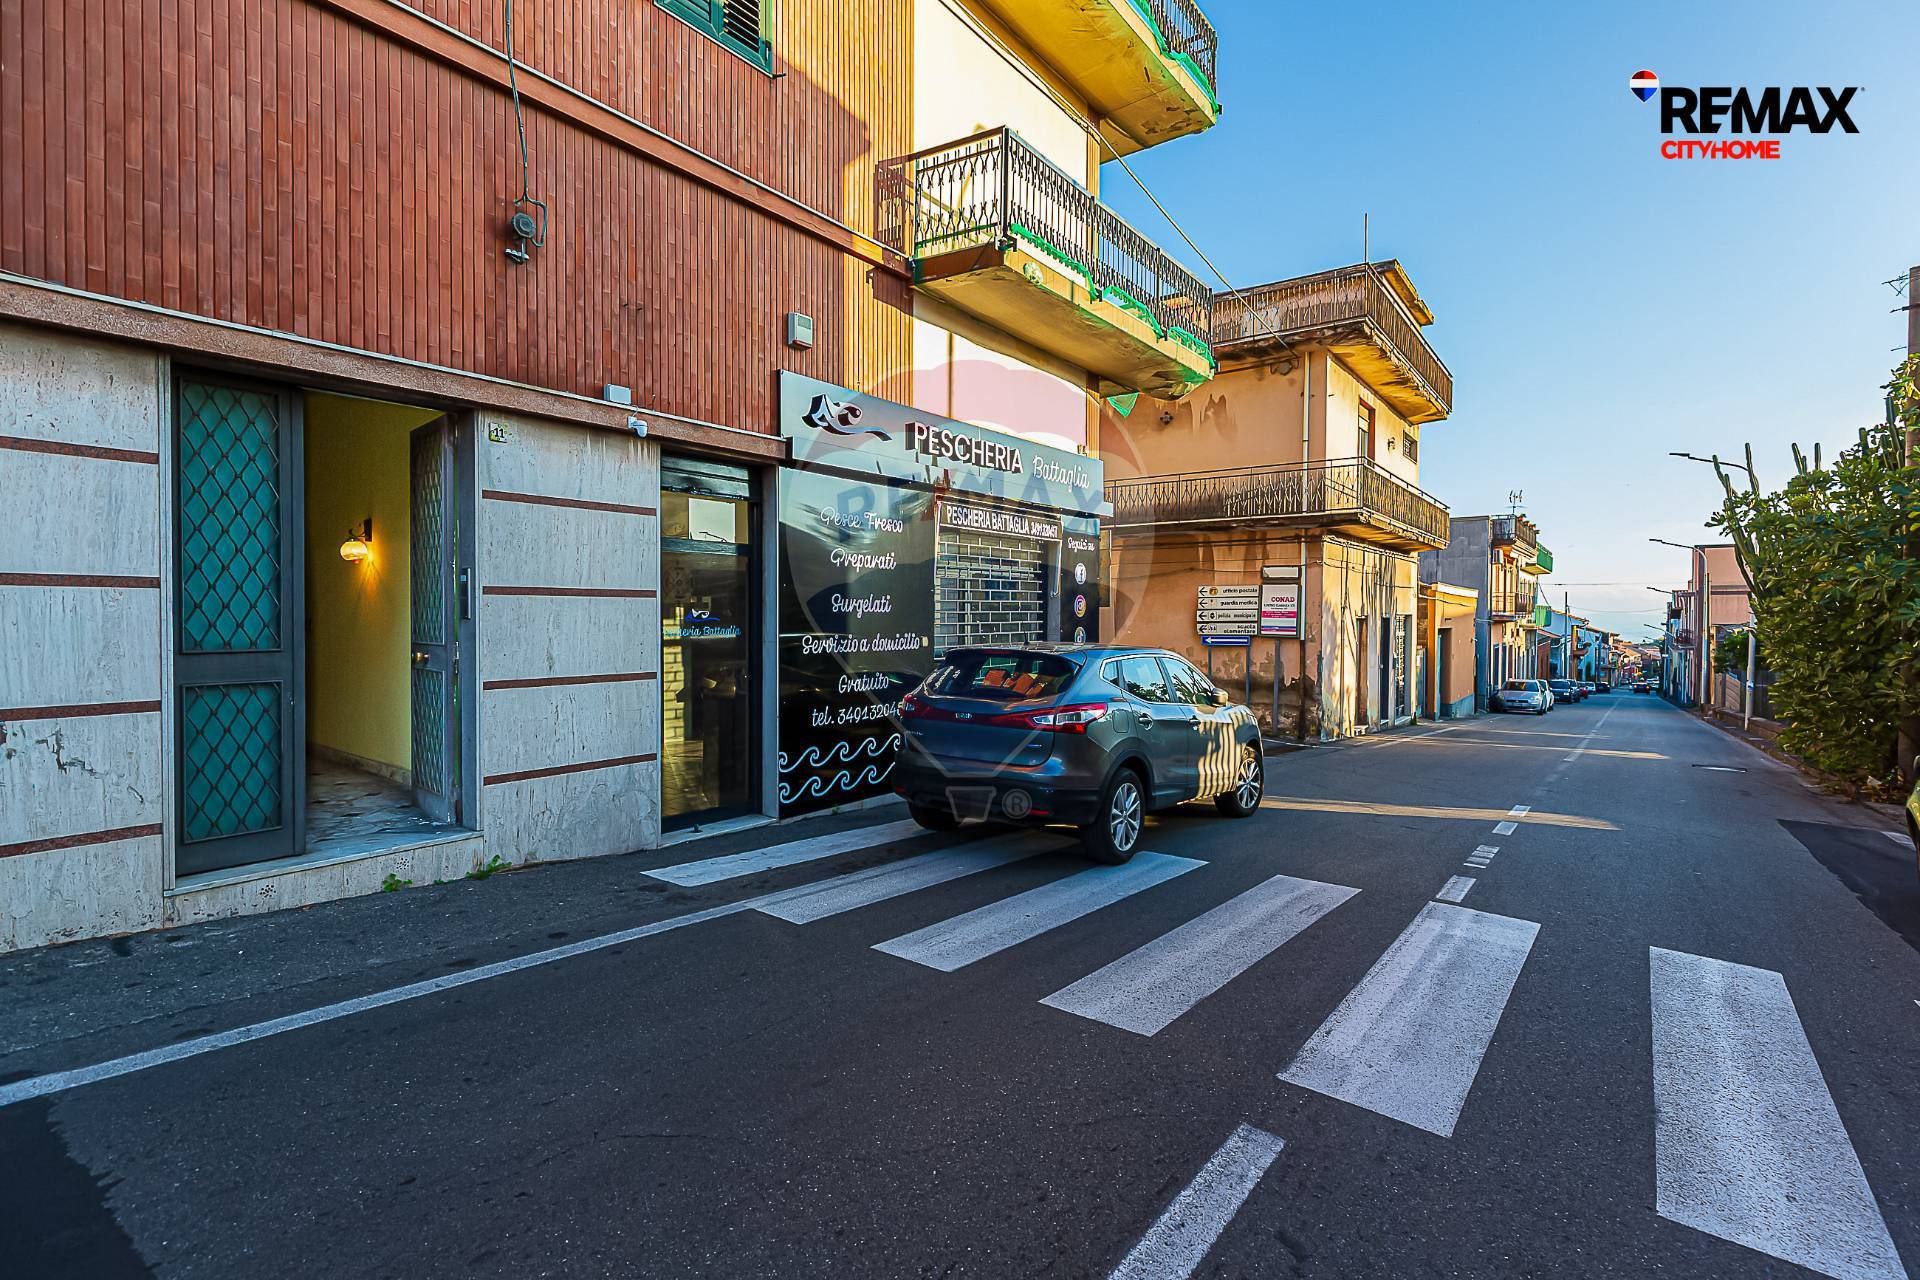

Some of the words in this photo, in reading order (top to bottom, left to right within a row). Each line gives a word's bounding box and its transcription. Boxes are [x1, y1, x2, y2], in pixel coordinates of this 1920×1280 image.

[493, 427, 505, 439] 11
[908, 421, 1024, 474] PESCHERIA
[1032, 454, 1090, 492] Battaglia
[820, 506, 862, 528] Pesce
[864, 511, 904, 533] Fresco
[946, 505, 991, 529] PESCHERIA
[991, 512, 1030, 535] BATTAGLIA
[830, 548, 897, 572] Preparati
[831, 593, 892, 621] Surgelati
[802, 634, 860, 655] Servizio
[859, 639, 870, 650] a
[871, 632, 920, 650] domicilio
[838, 673, 890, 694] Gratuito
[811, 705, 835, 727] tel.
